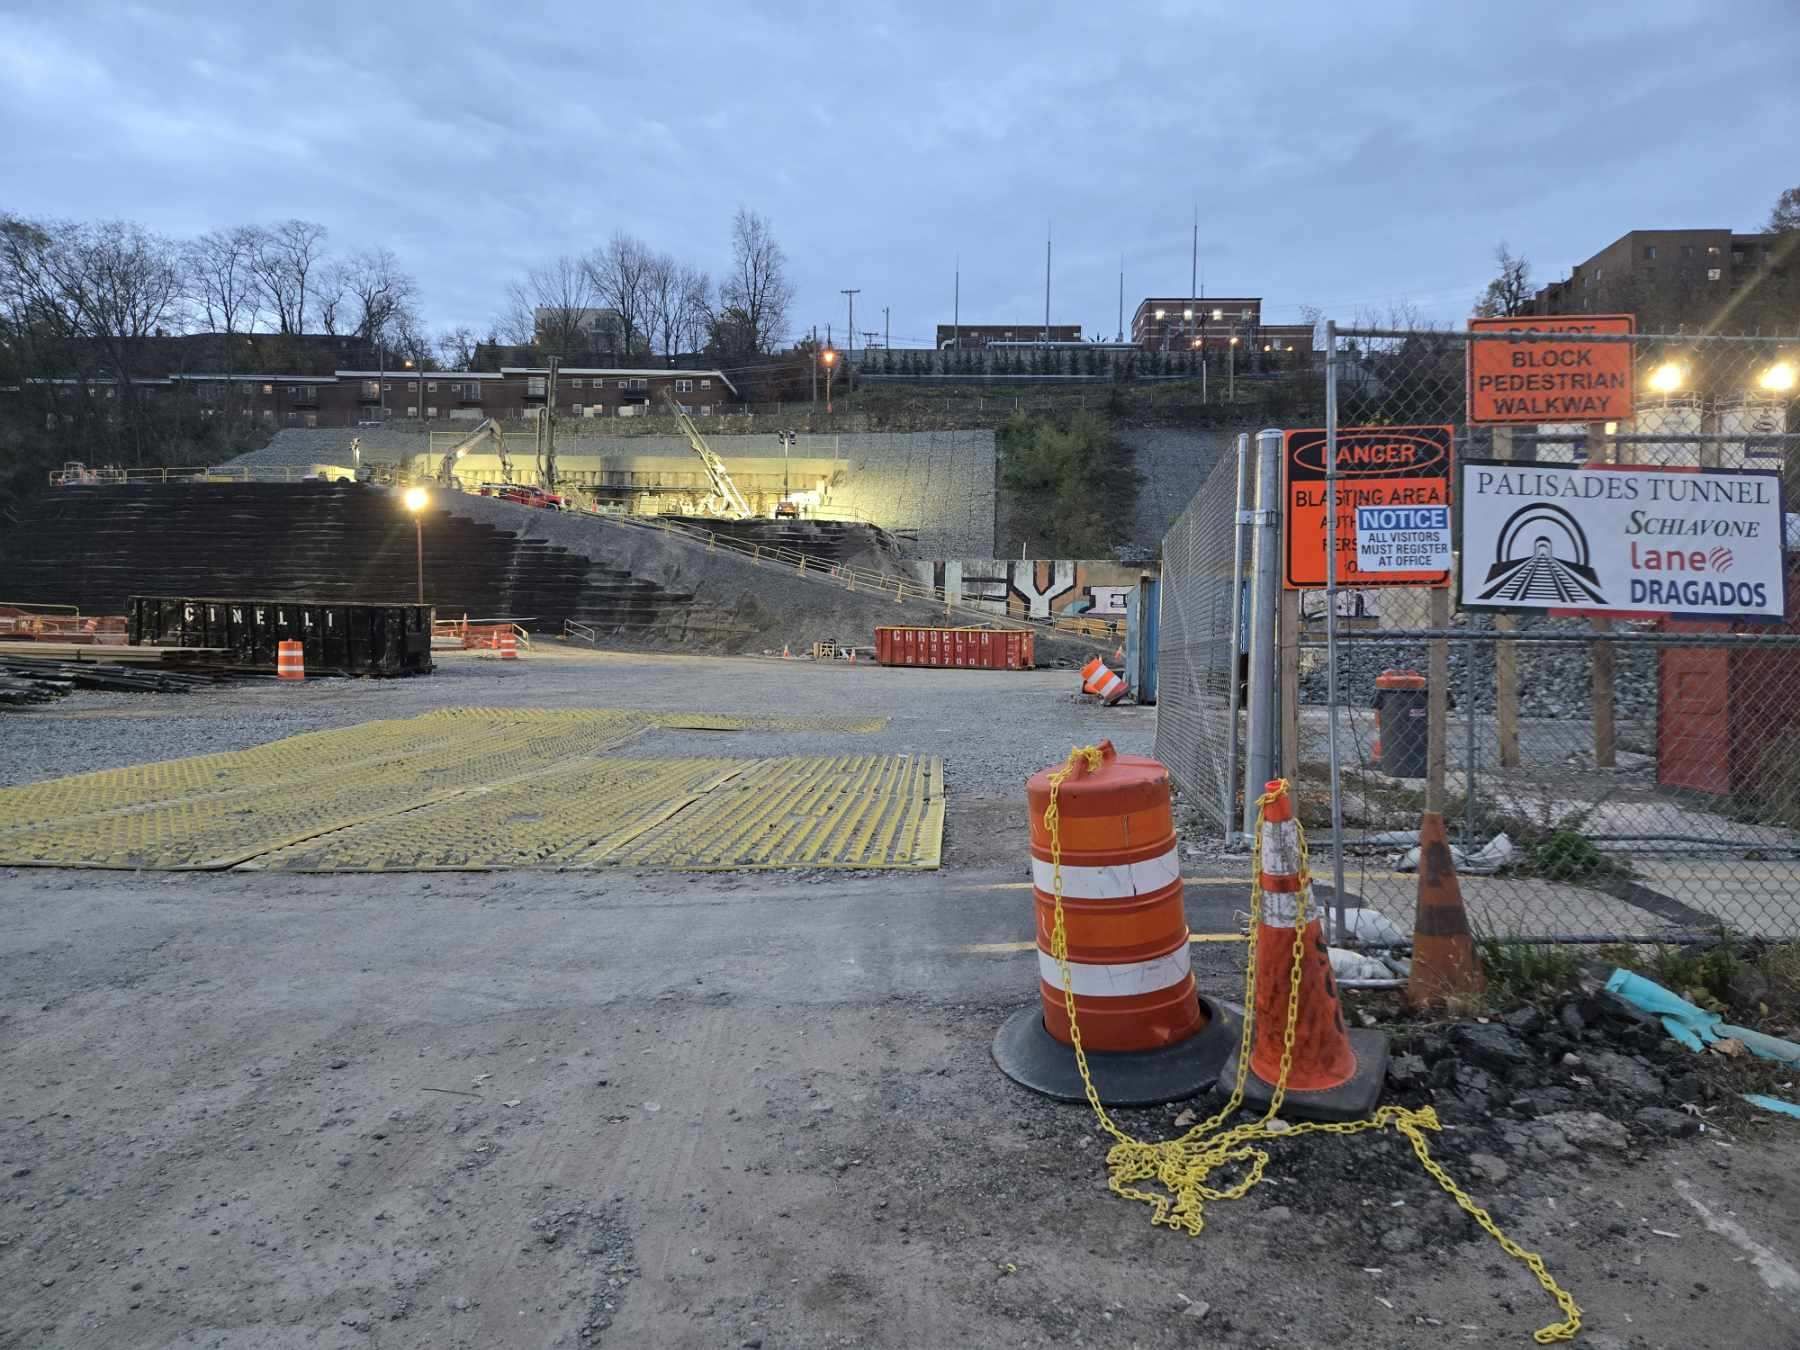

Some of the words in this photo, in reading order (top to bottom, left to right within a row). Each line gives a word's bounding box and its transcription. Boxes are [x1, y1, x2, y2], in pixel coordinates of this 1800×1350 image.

[1512, 349, 1592, 367] BLOCK
[1479, 372, 1625, 392] PEDESTRIAN
[1493, 397, 1611, 414] WALKWAY
[1389, 487, 1439, 505] AREA
[1476, 472, 1639, 499] PALISADES
[1647, 478, 1771, 505] TUNNEL
[1362, 510, 1445, 529] NOTICE
[1368, 532, 1388, 543] ALL
[1389, 532, 1440, 543] VISITORS
[1361, 545, 1394, 555] MUST
[1396, 544, 1448, 554] REGISTER
[1630, 541, 1707, 571] lane
[1378, 556, 1394, 567] AT
[1396, 555, 1432, 566] OFFICE
[1630, 578, 1767, 607] DRAGADOS
[184, 606, 333, 627] CINELLI
